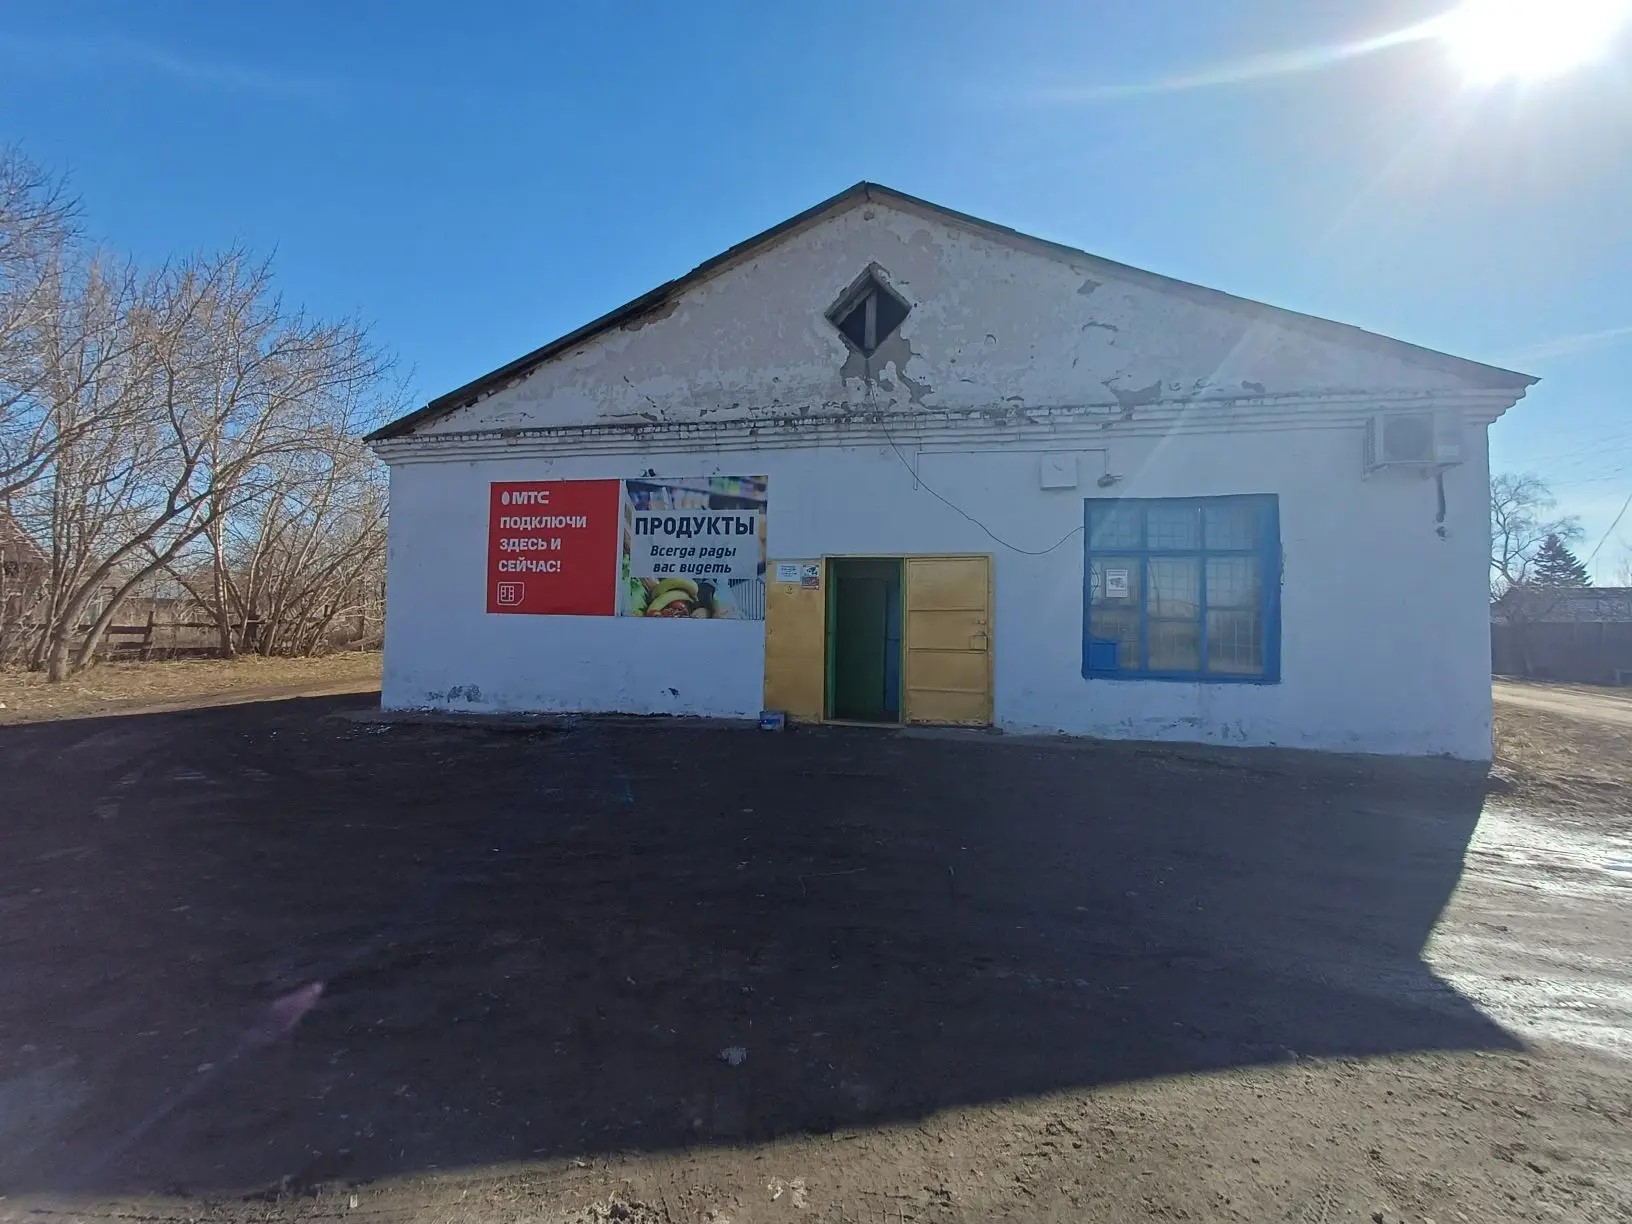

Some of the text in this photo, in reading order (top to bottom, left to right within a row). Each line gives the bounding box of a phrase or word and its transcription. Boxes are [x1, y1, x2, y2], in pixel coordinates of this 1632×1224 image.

[511, 491, 550, 505] МТС
[500, 516, 587, 531] ПОДКЛЮЧИ
[635, 516, 755, 538] ПРОДУКТЫ
[500, 538, 561, 552] ЗДЕСЬ И
[650, 545, 737, 558] Всегда рады
[498, 557, 561, 572] СЕЙЧАС!
[653, 563, 732, 575] вас видеть
